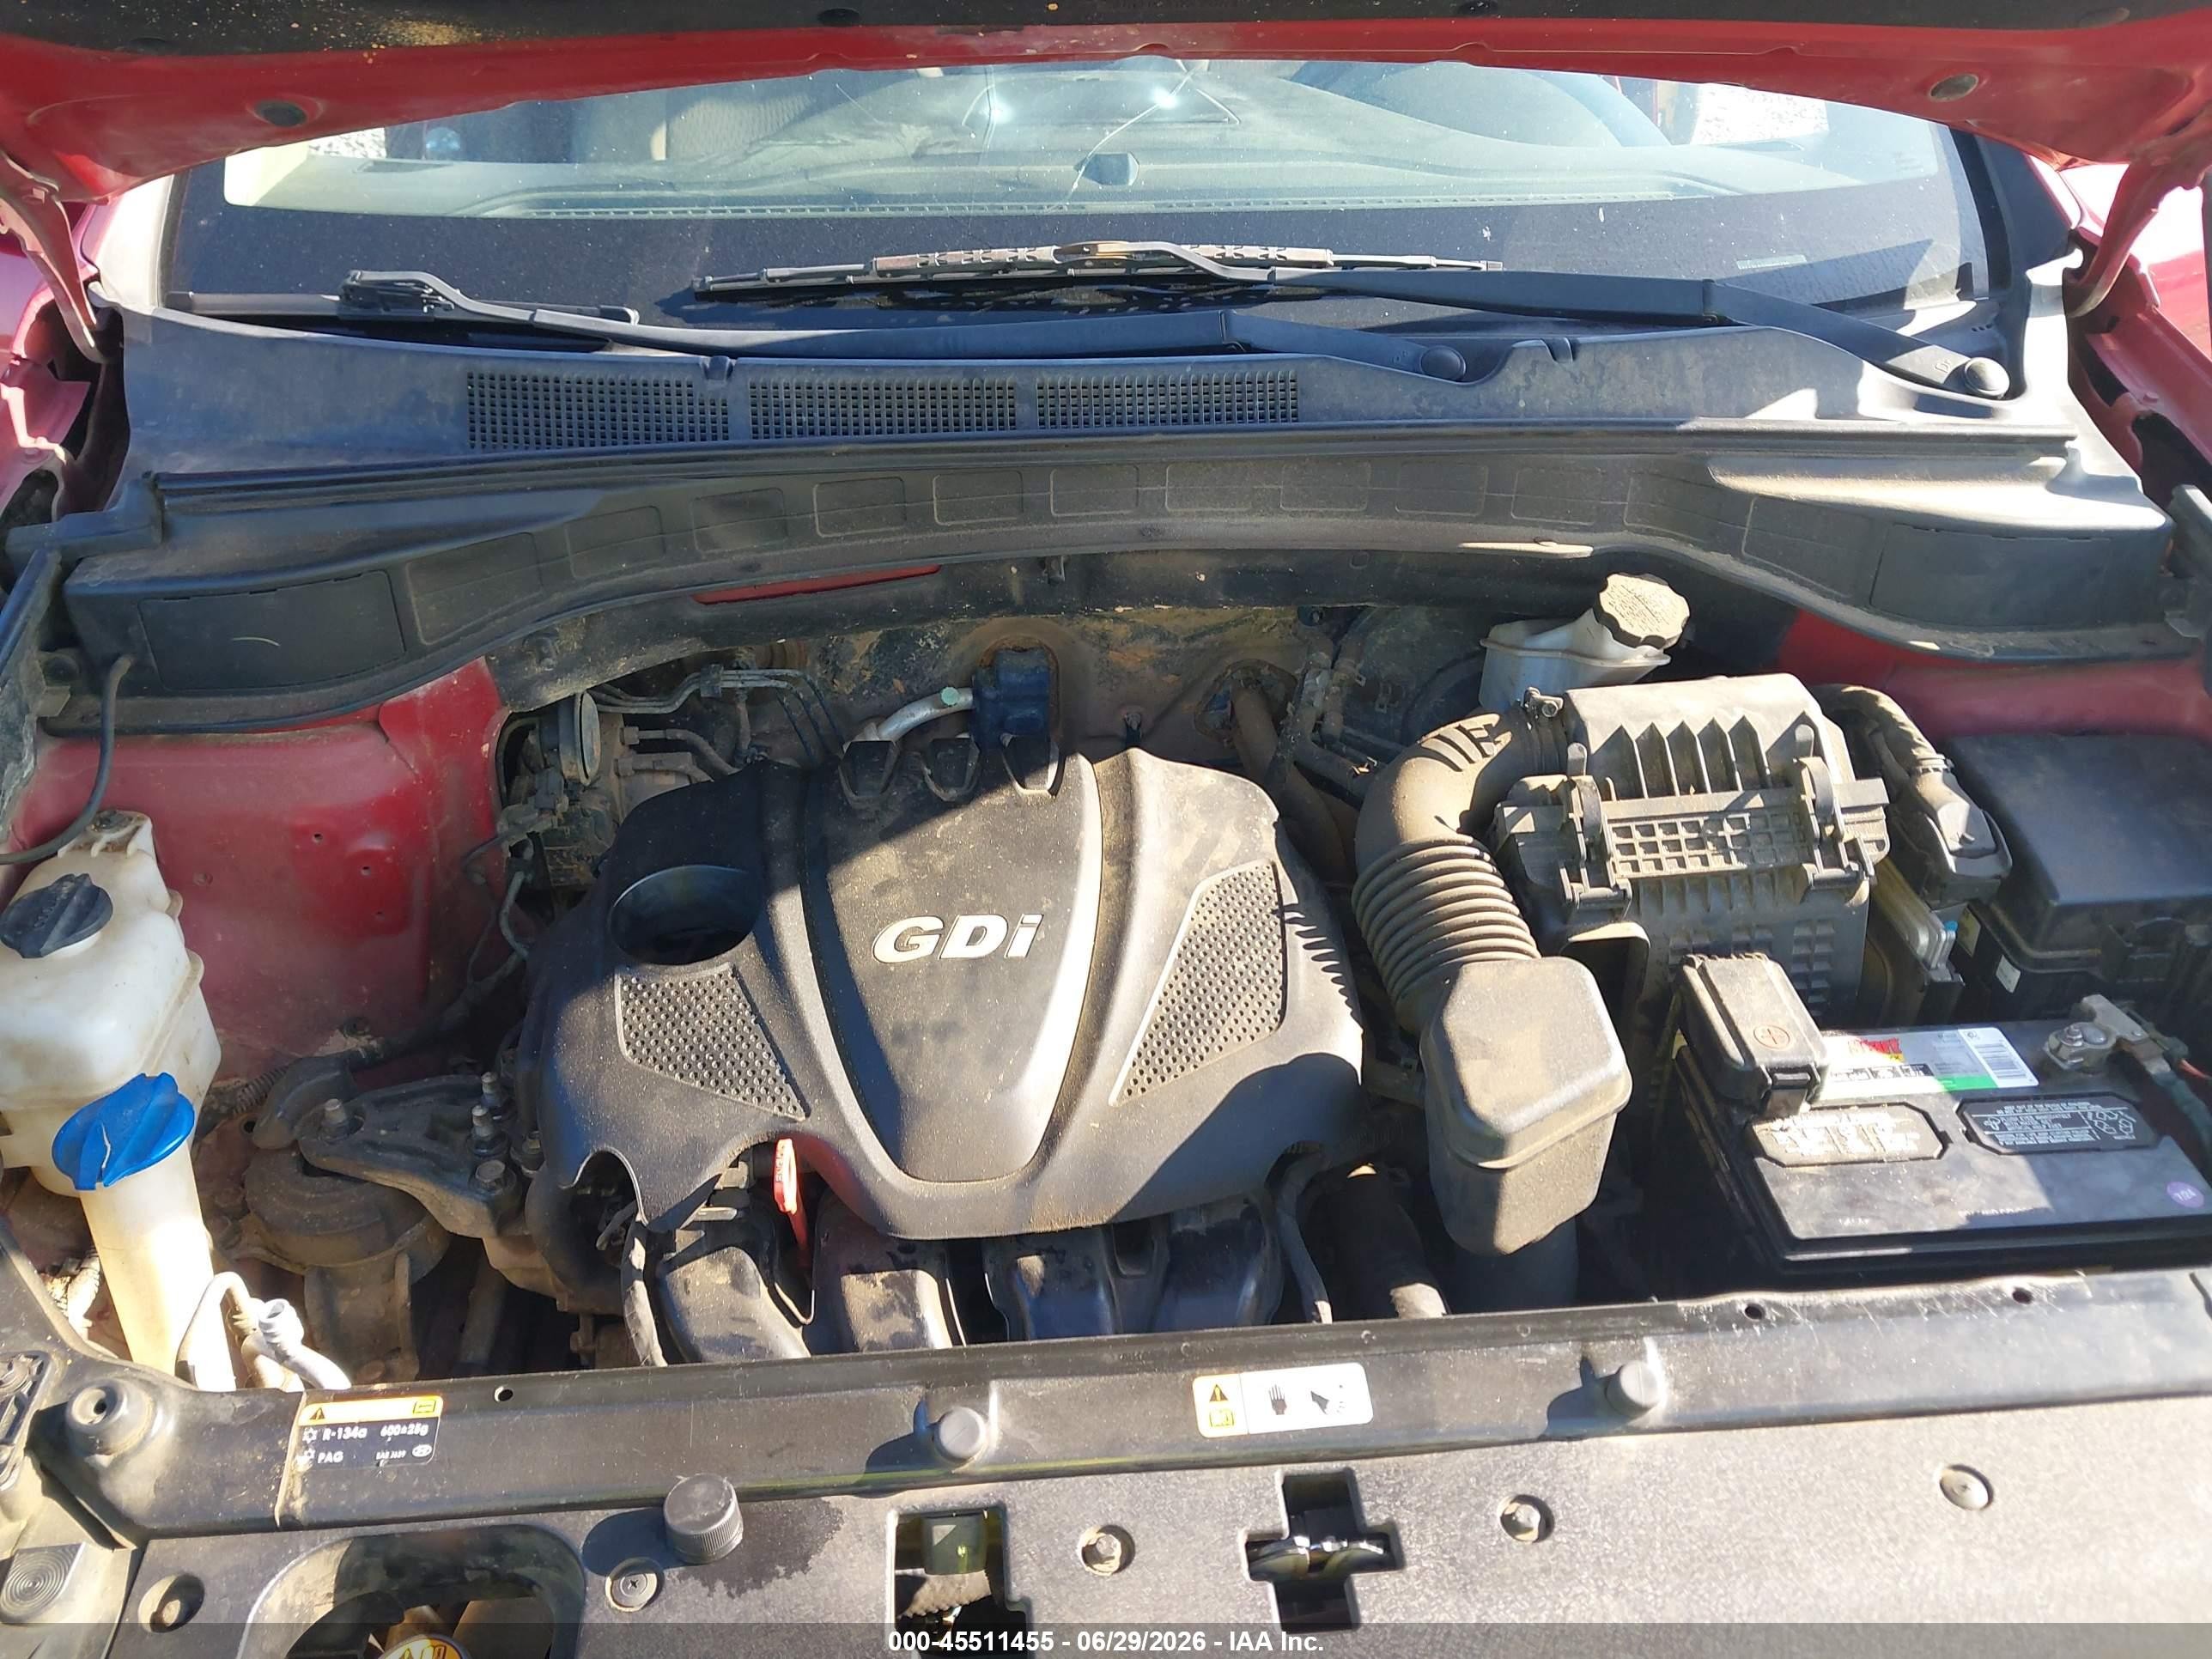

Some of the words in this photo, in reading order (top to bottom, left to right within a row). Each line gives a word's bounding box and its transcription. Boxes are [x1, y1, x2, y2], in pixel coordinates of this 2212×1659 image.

[872, 913, 1045, 963] GDi
[322, 1426, 368, 1441] R-134a
[318, 1451, 343, 1463] PAG
